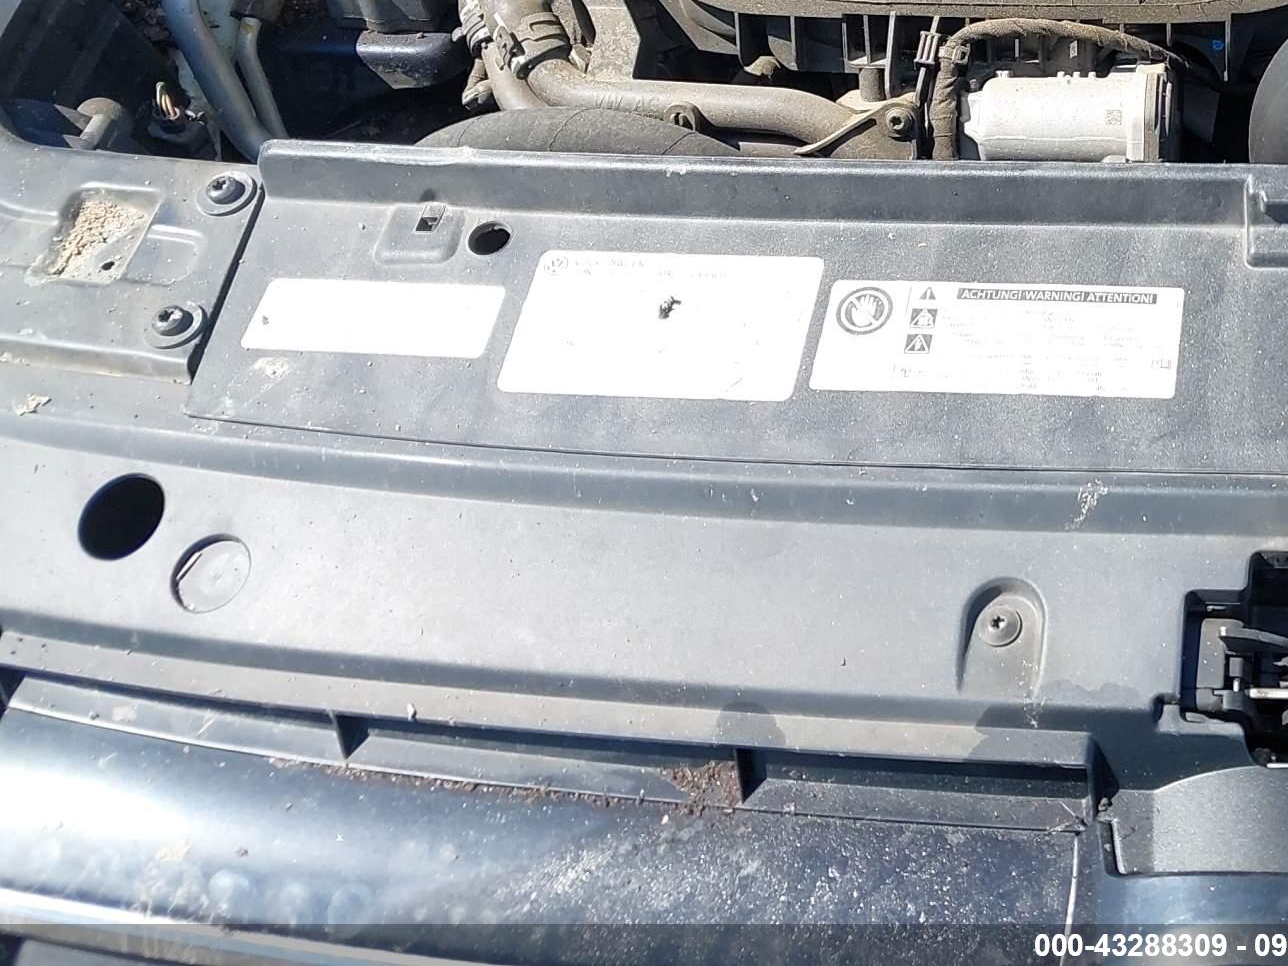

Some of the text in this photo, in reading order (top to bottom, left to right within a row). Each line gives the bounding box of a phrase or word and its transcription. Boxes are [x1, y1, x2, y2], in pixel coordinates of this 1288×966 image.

[961, 289, 1154, 304] ACHTUNG! WARNING! ATTENTION!
